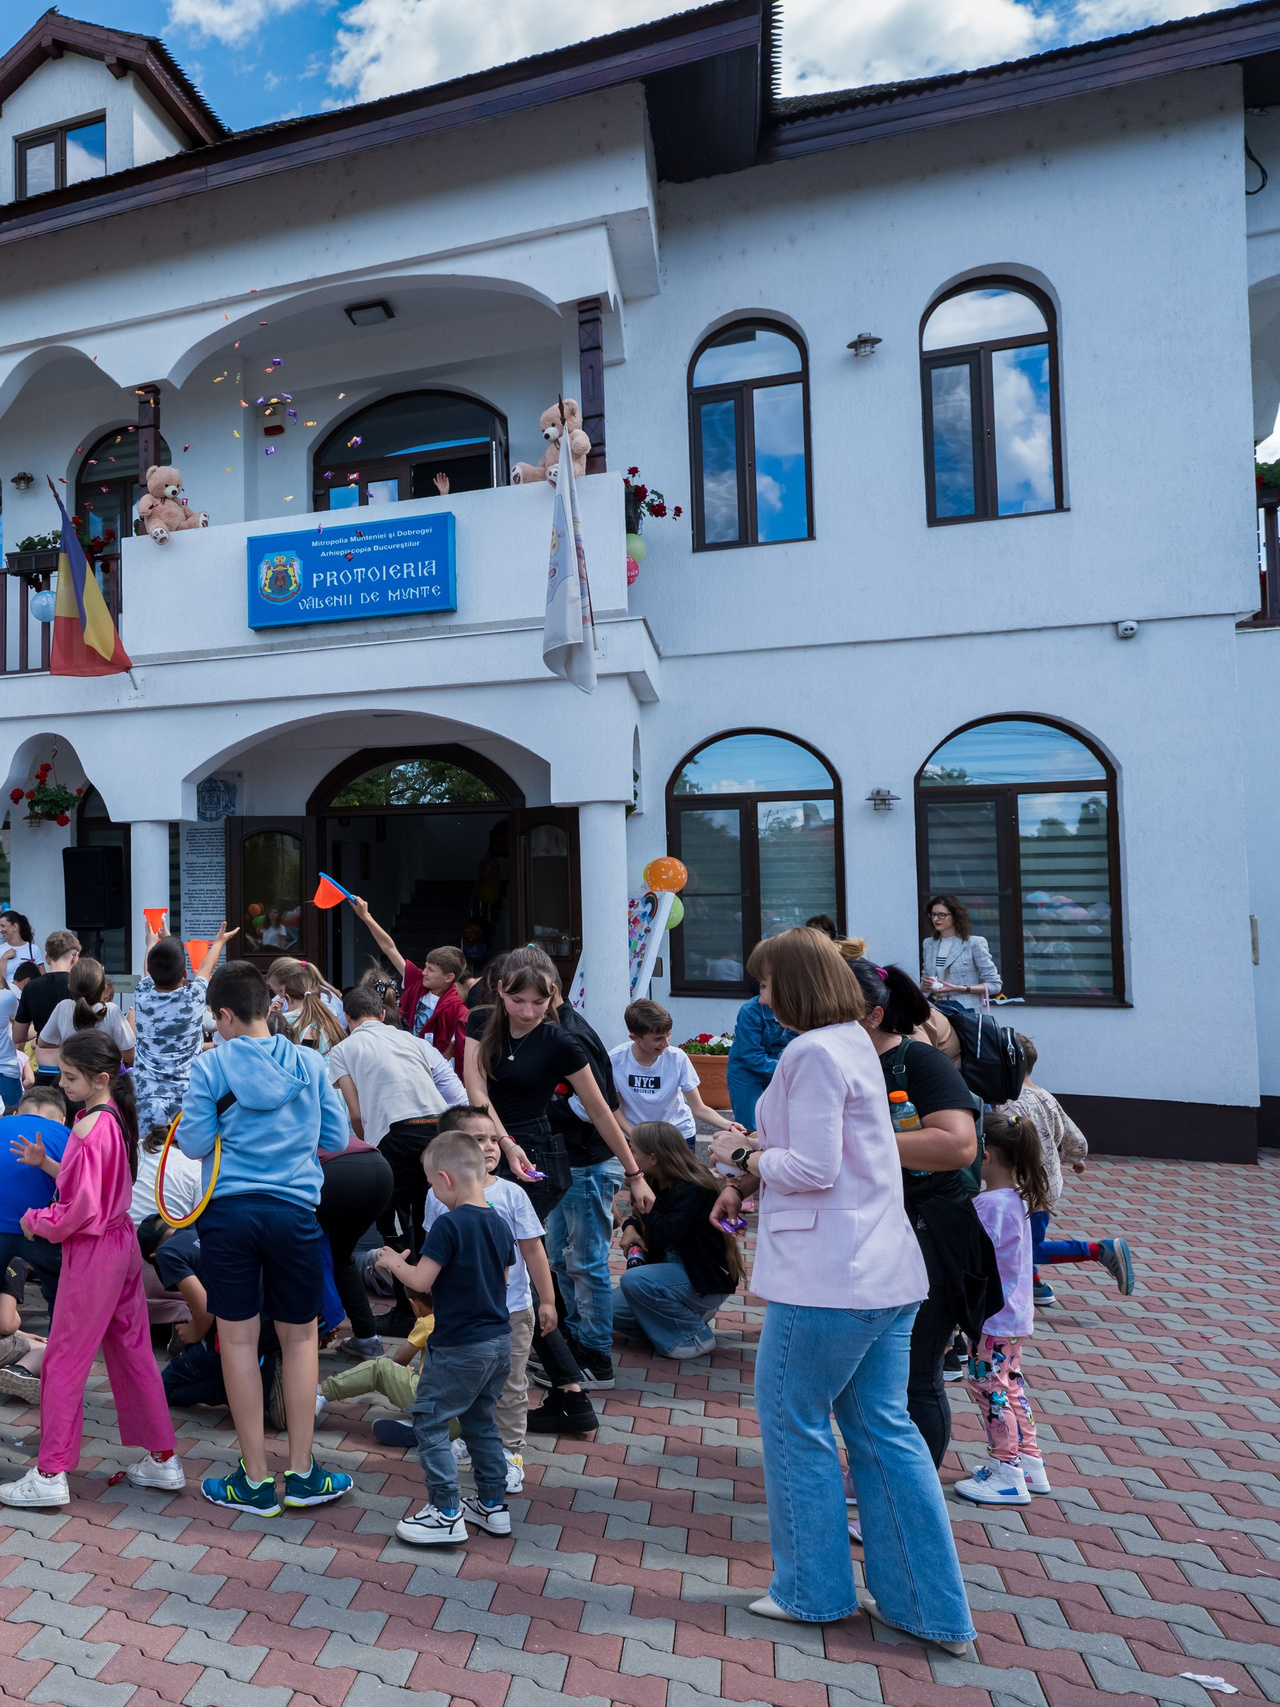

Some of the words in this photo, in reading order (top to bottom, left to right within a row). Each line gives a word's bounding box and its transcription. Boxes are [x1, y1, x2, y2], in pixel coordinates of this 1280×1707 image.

[311, 537, 348, 547] Mitropolia
[397, 526, 432, 537] Dobrogei
[313, 559, 436, 588] PROTOIERIA
[298, 593, 352, 610] VĂLENII
[360, 591, 380, 604] DE
[388, 584, 442, 601] MUNTE
[634, 1076, 655, 1088] NYC
